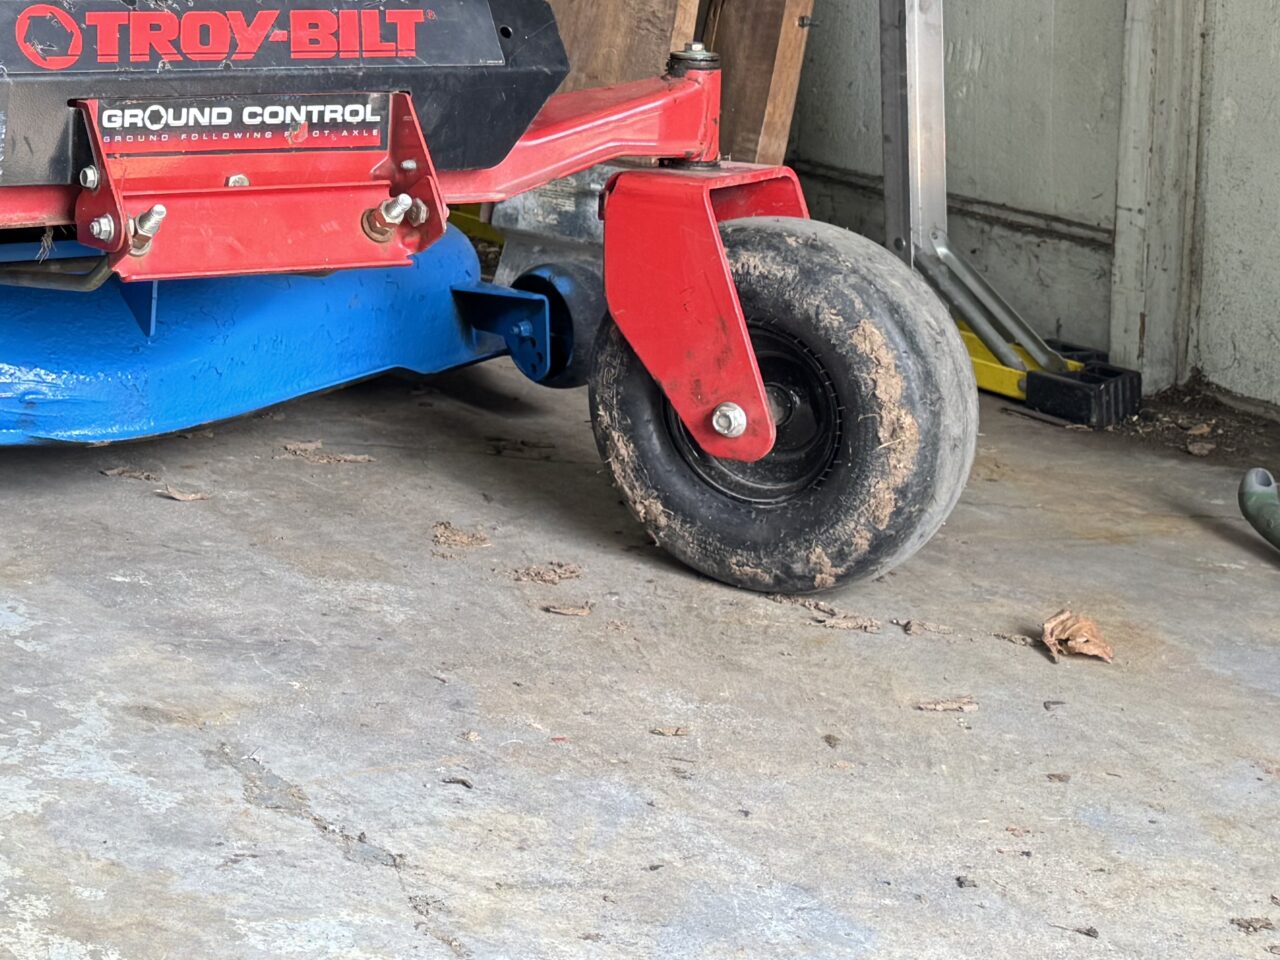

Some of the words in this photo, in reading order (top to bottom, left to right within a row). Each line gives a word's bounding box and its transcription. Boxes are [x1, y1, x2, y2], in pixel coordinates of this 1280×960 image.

[86, 9, 424, 63] TROY-BILT
[101, 104, 233, 131] GROUND
[242, 103, 381, 126] CONTROL
[102, 133, 169, 143] GROUND
[181, 131, 273, 141] FOLLOWING
[341, 128, 379, 137] AXLE
